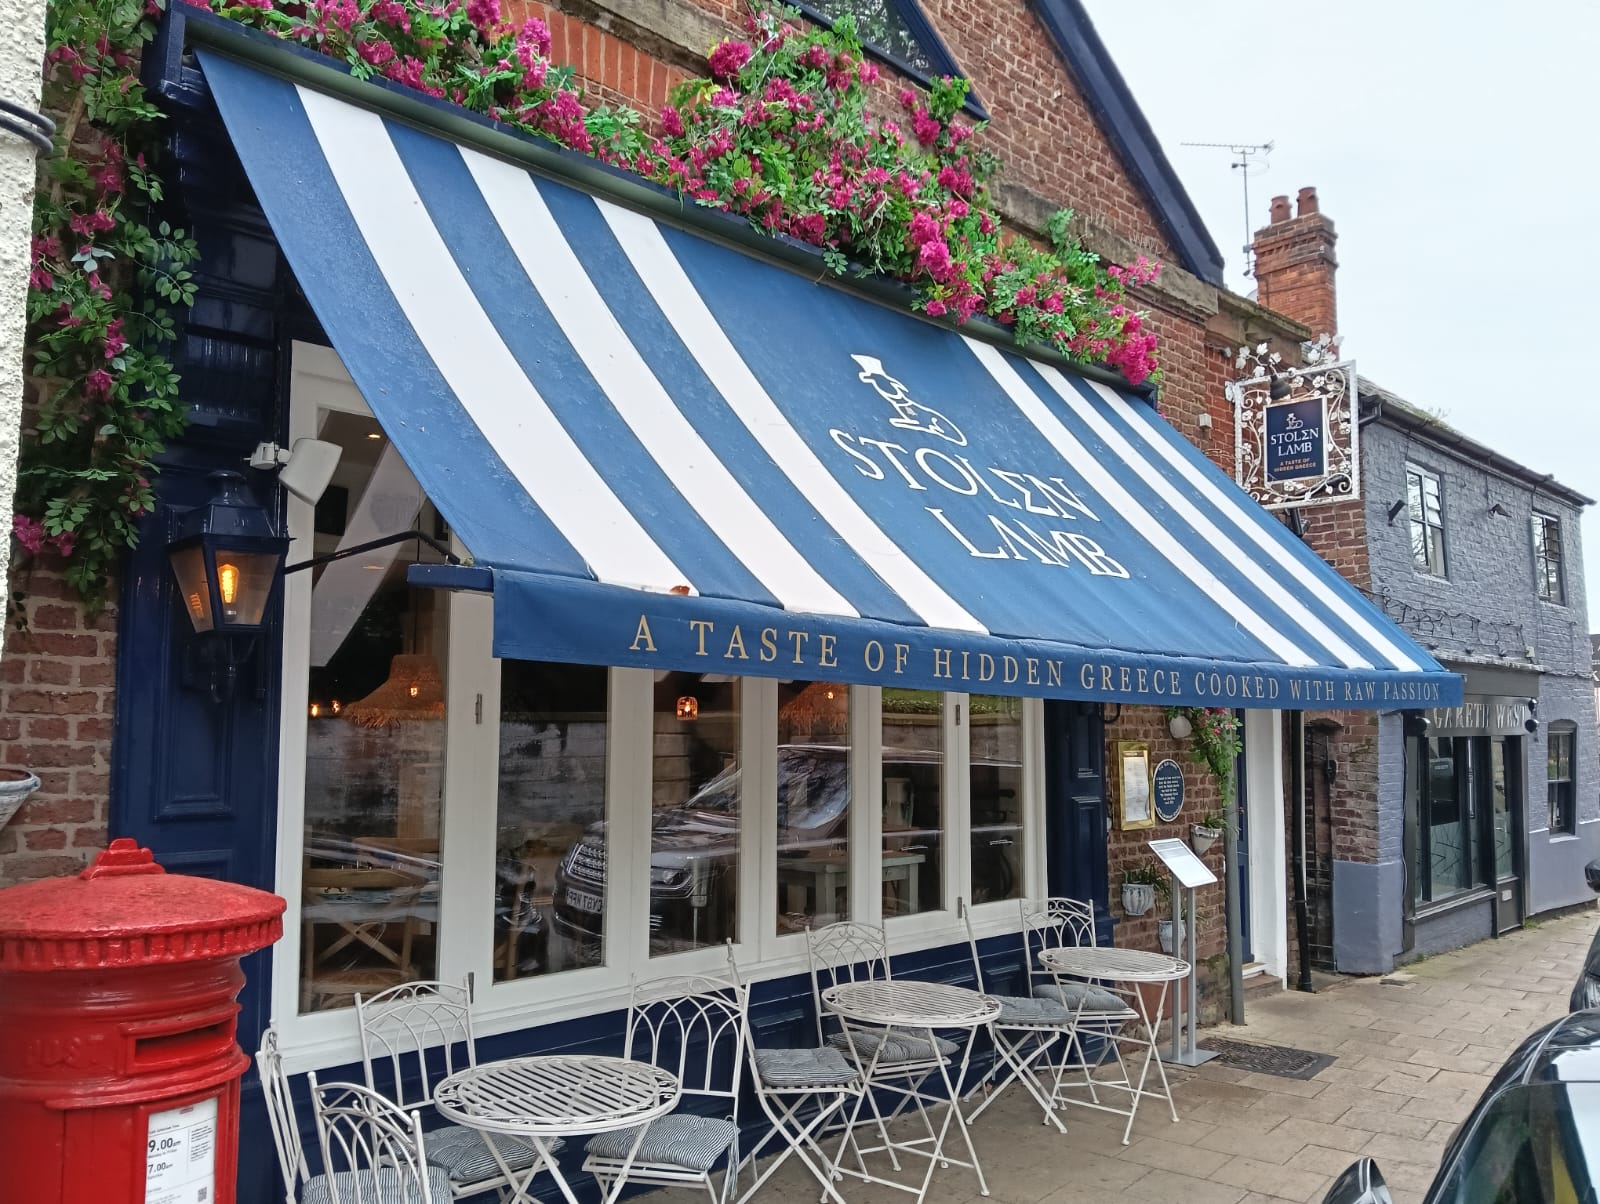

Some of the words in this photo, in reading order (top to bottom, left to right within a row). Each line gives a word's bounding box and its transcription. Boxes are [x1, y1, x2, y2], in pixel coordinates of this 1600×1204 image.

[629, 614, 658, 652] A
[690, 620, 838, 667] TASTE
[864, 640, 910, 674] OF
[933, 648, 1064, 688] HIDDEN
[1080, 663, 1182, 695] GREECE
[1195, 672, 1279, 699] COOKED
[1289, 679, 1335, 701] WITH
[1345, 681, 1376, 701] RAW
[1384, 681, 1440, 701] PASSION
[1496, 703, 1527, 728] WEST
